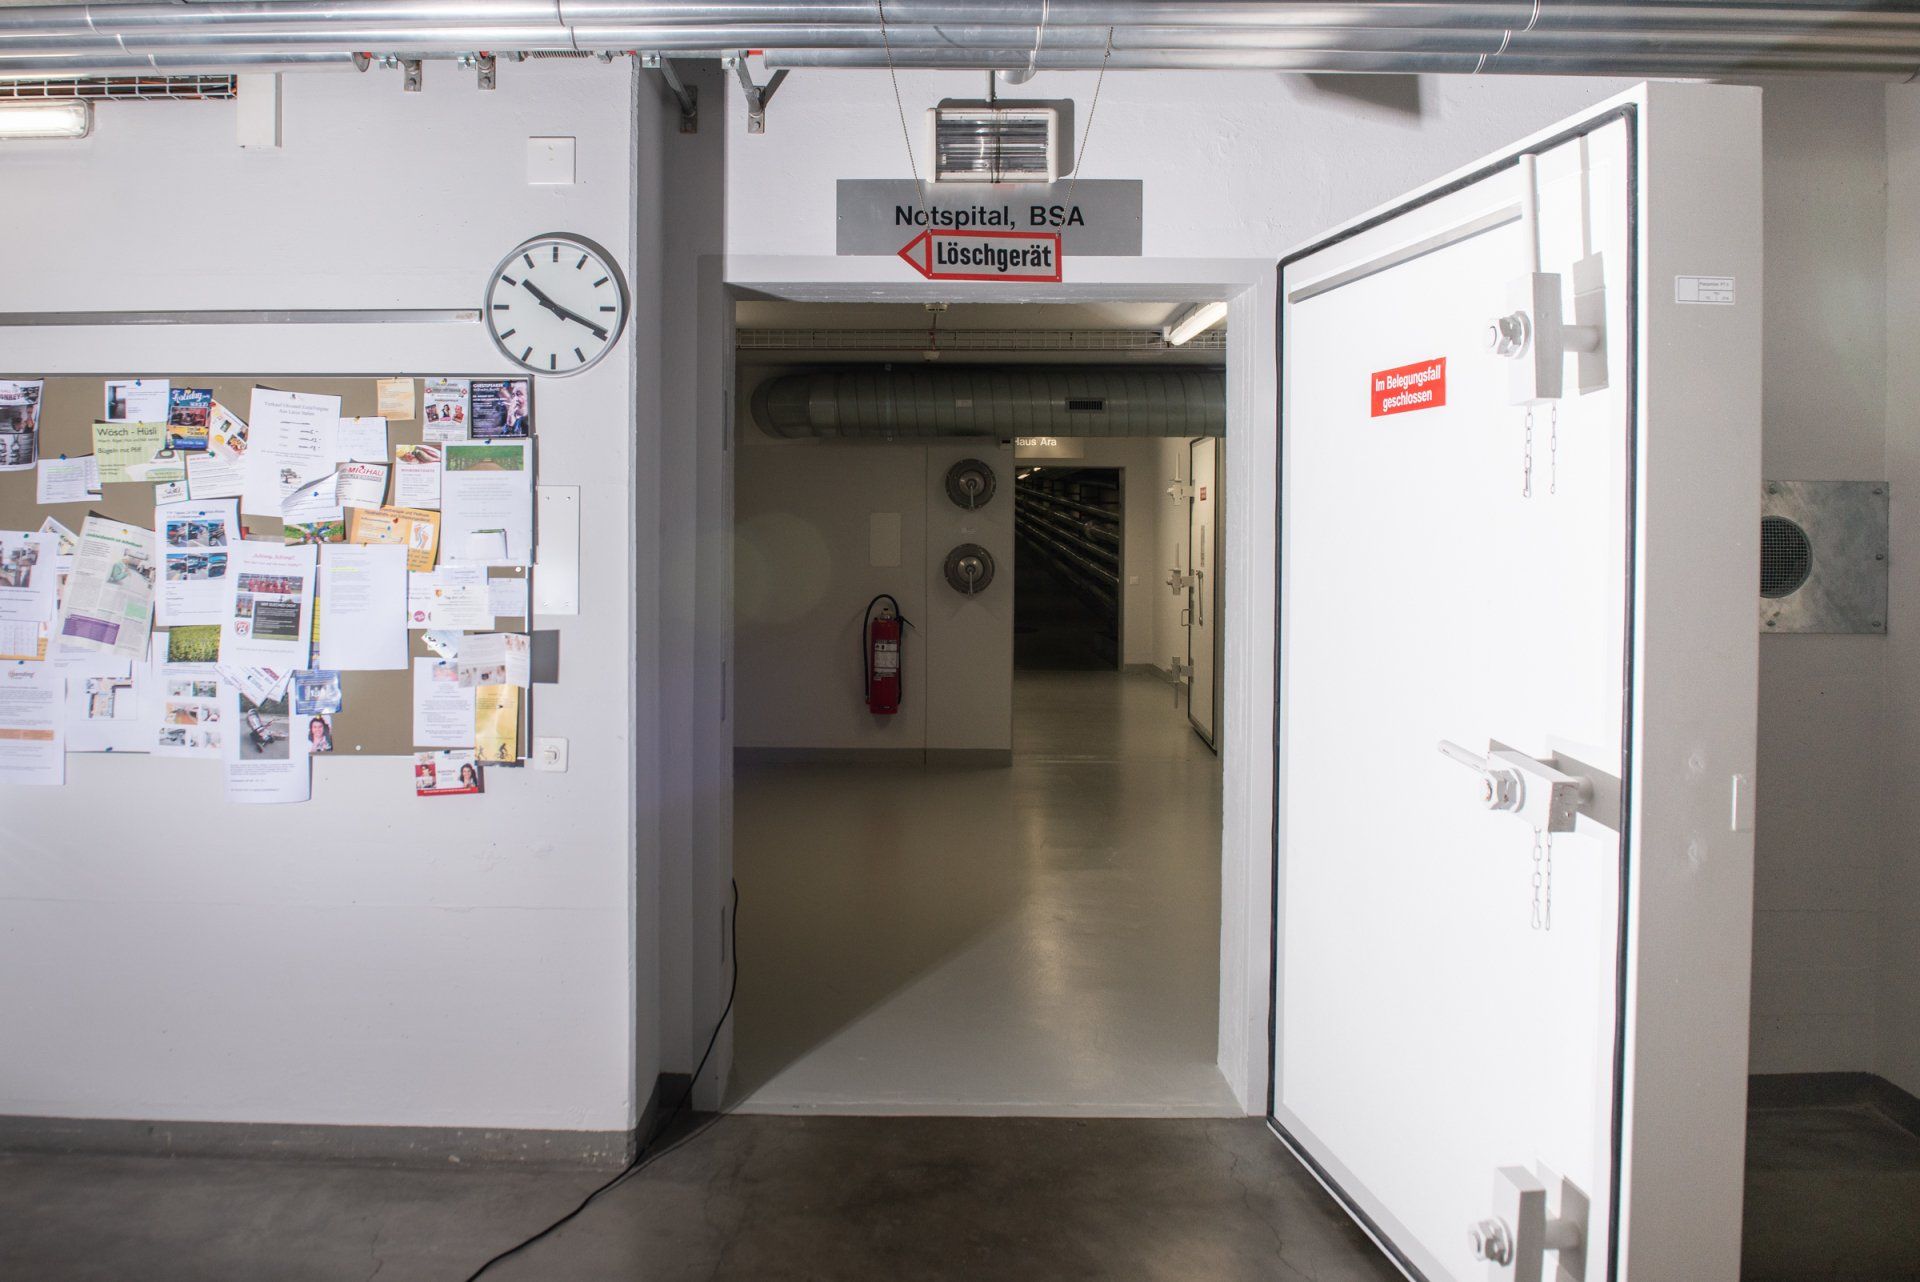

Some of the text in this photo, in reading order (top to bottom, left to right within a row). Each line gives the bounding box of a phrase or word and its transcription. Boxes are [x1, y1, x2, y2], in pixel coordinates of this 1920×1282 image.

[895, 205, 1085, 230] Notspital, BSA
[937, 241, 1052, 272] Löschgerät
[1375, 364, 1441, 392] Im Belegungsfall
[1382, 389, 1433, 413] geschlossen
[1040, 438, 1057, 446] Ara
